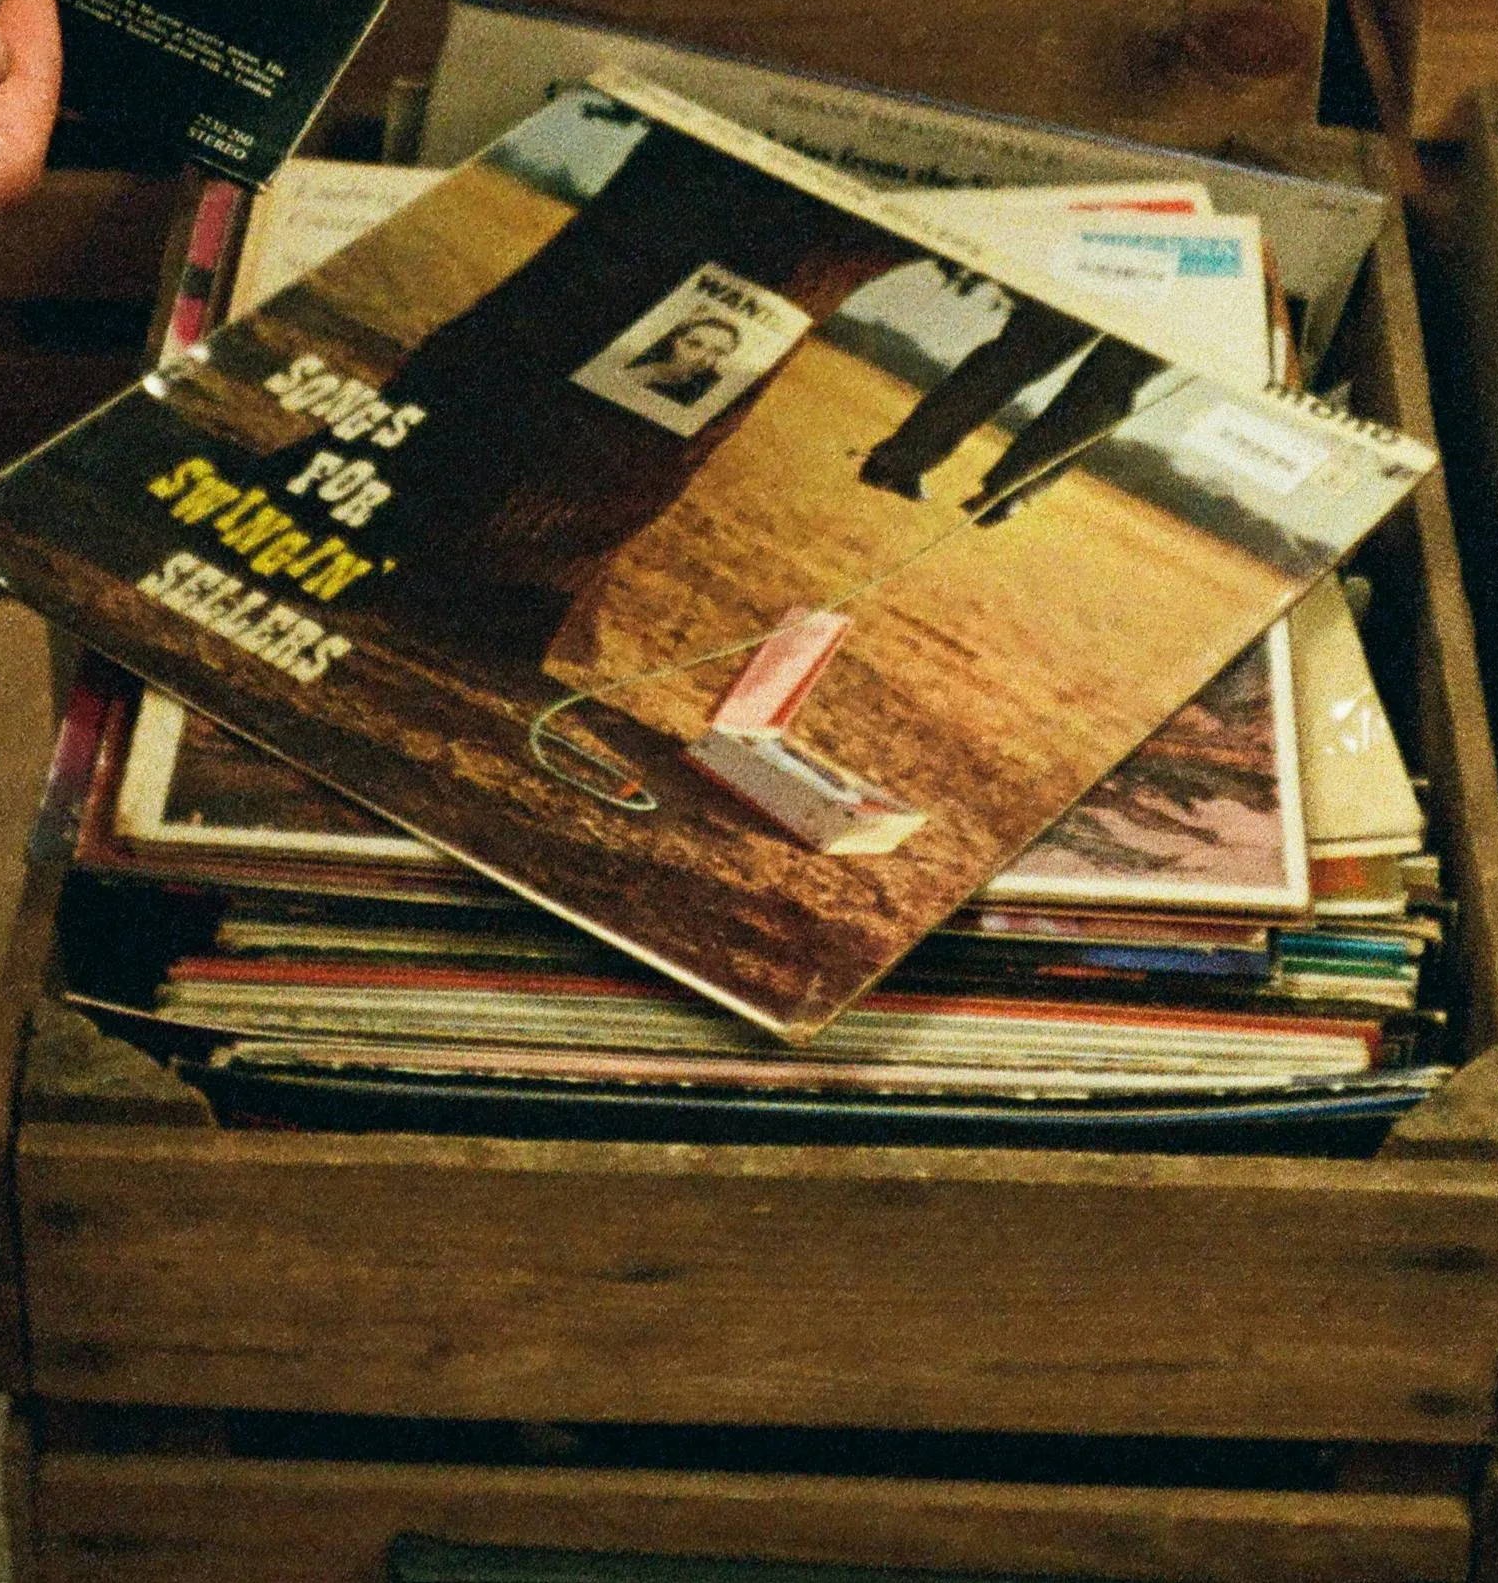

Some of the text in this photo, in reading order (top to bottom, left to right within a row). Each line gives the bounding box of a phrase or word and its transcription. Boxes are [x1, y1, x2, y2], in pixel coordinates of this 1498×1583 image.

[185, 125, 248, 161] STEREO
[263, 353, 427, 448] SONGS
[147, 457, 398, 602] SWINGIN'
[286, 451, 393, 528] FOR
[136, 552, 353, 682] SELLERS
